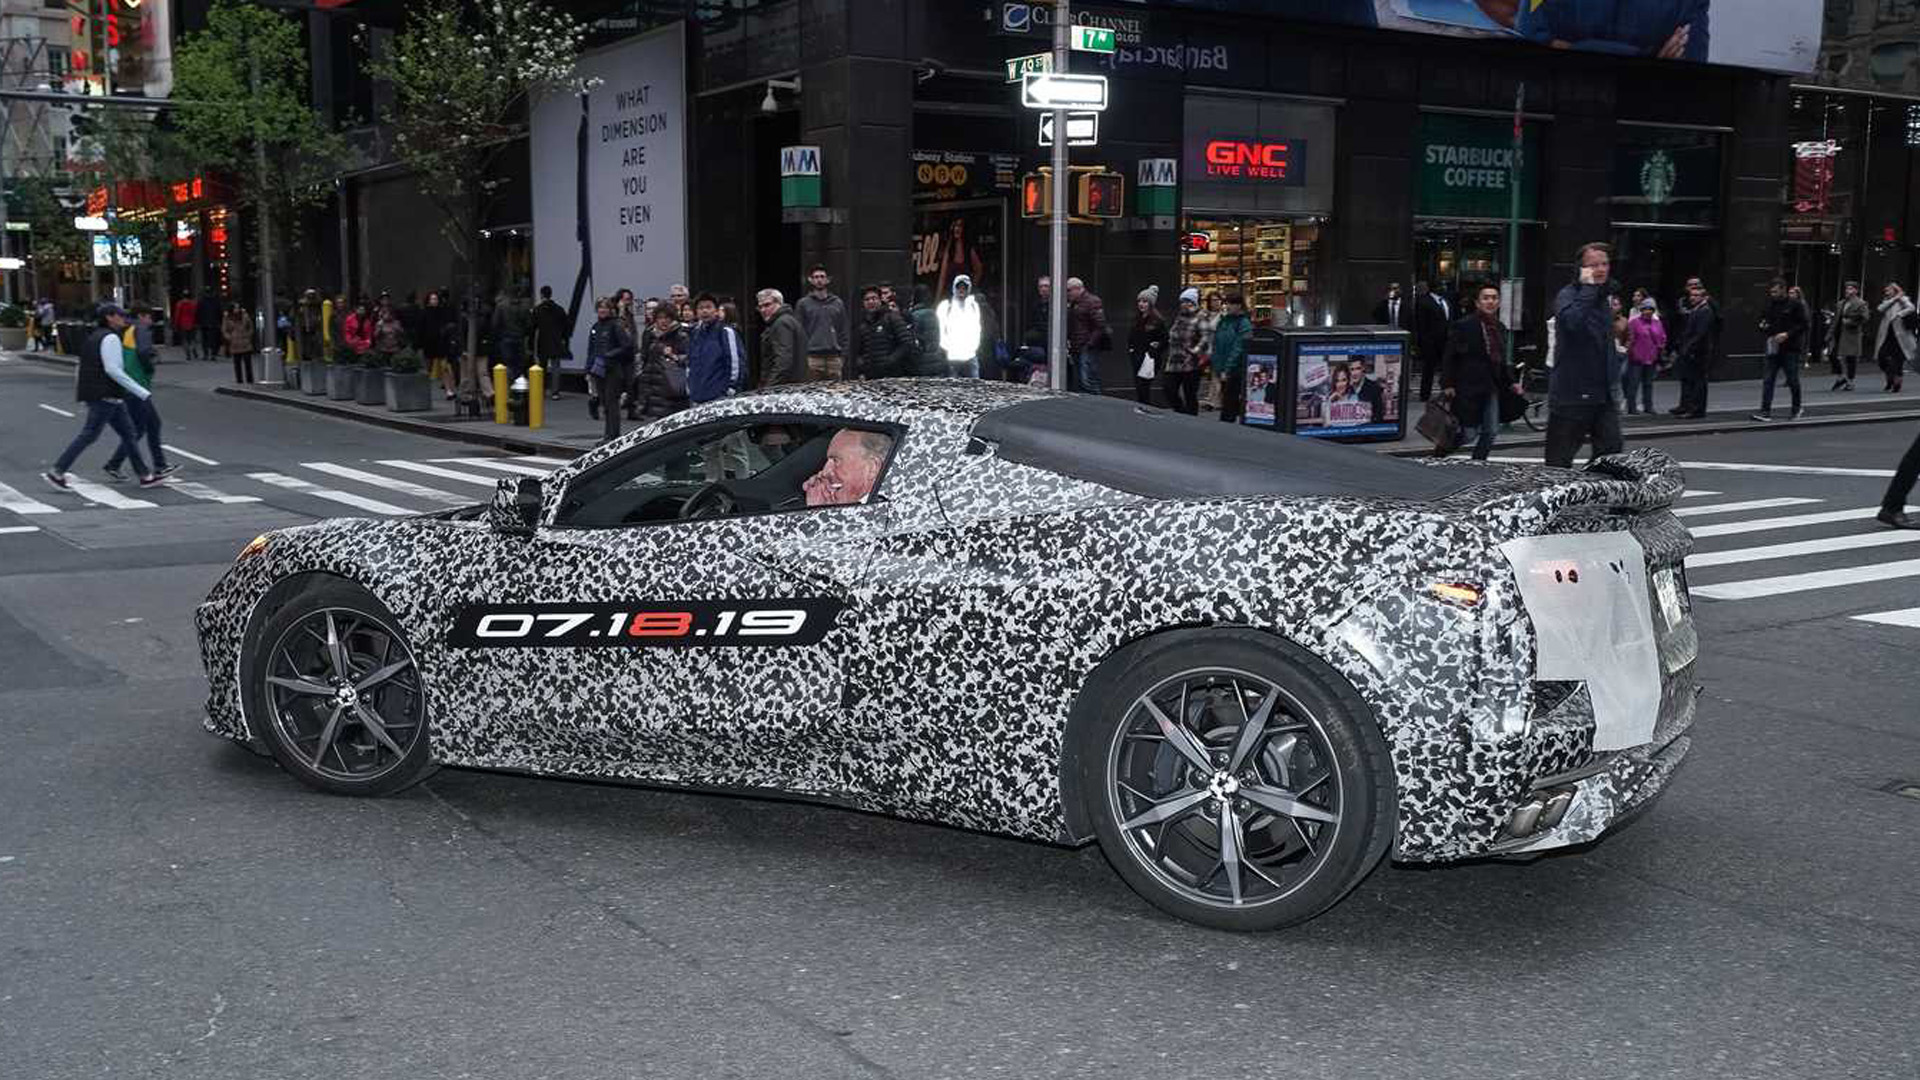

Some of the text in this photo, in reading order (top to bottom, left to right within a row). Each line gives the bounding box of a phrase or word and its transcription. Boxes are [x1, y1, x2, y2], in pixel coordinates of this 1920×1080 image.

[1085, 30, 1096, 49] 7
[1007, 60, 1018, 80] W
[1019, 58, 1035, 75] 49
[616, 85, 651, 111] WHAT
[601, 112, 668, 142] DIMENSION
[622, 146, 646, 168] ARE
[1206, 142, 1286, 167] GNC
[1207, 165, 1286, 178] LIVE WELL
[1444, 168, 1506, 189] COFFEE
[622, 175, 647, 195] YOU
[620, 205, 652, 226] EVEN
[626, 234, 645, 253] IN?
[476, 610, 807, 637] 07.18.19
